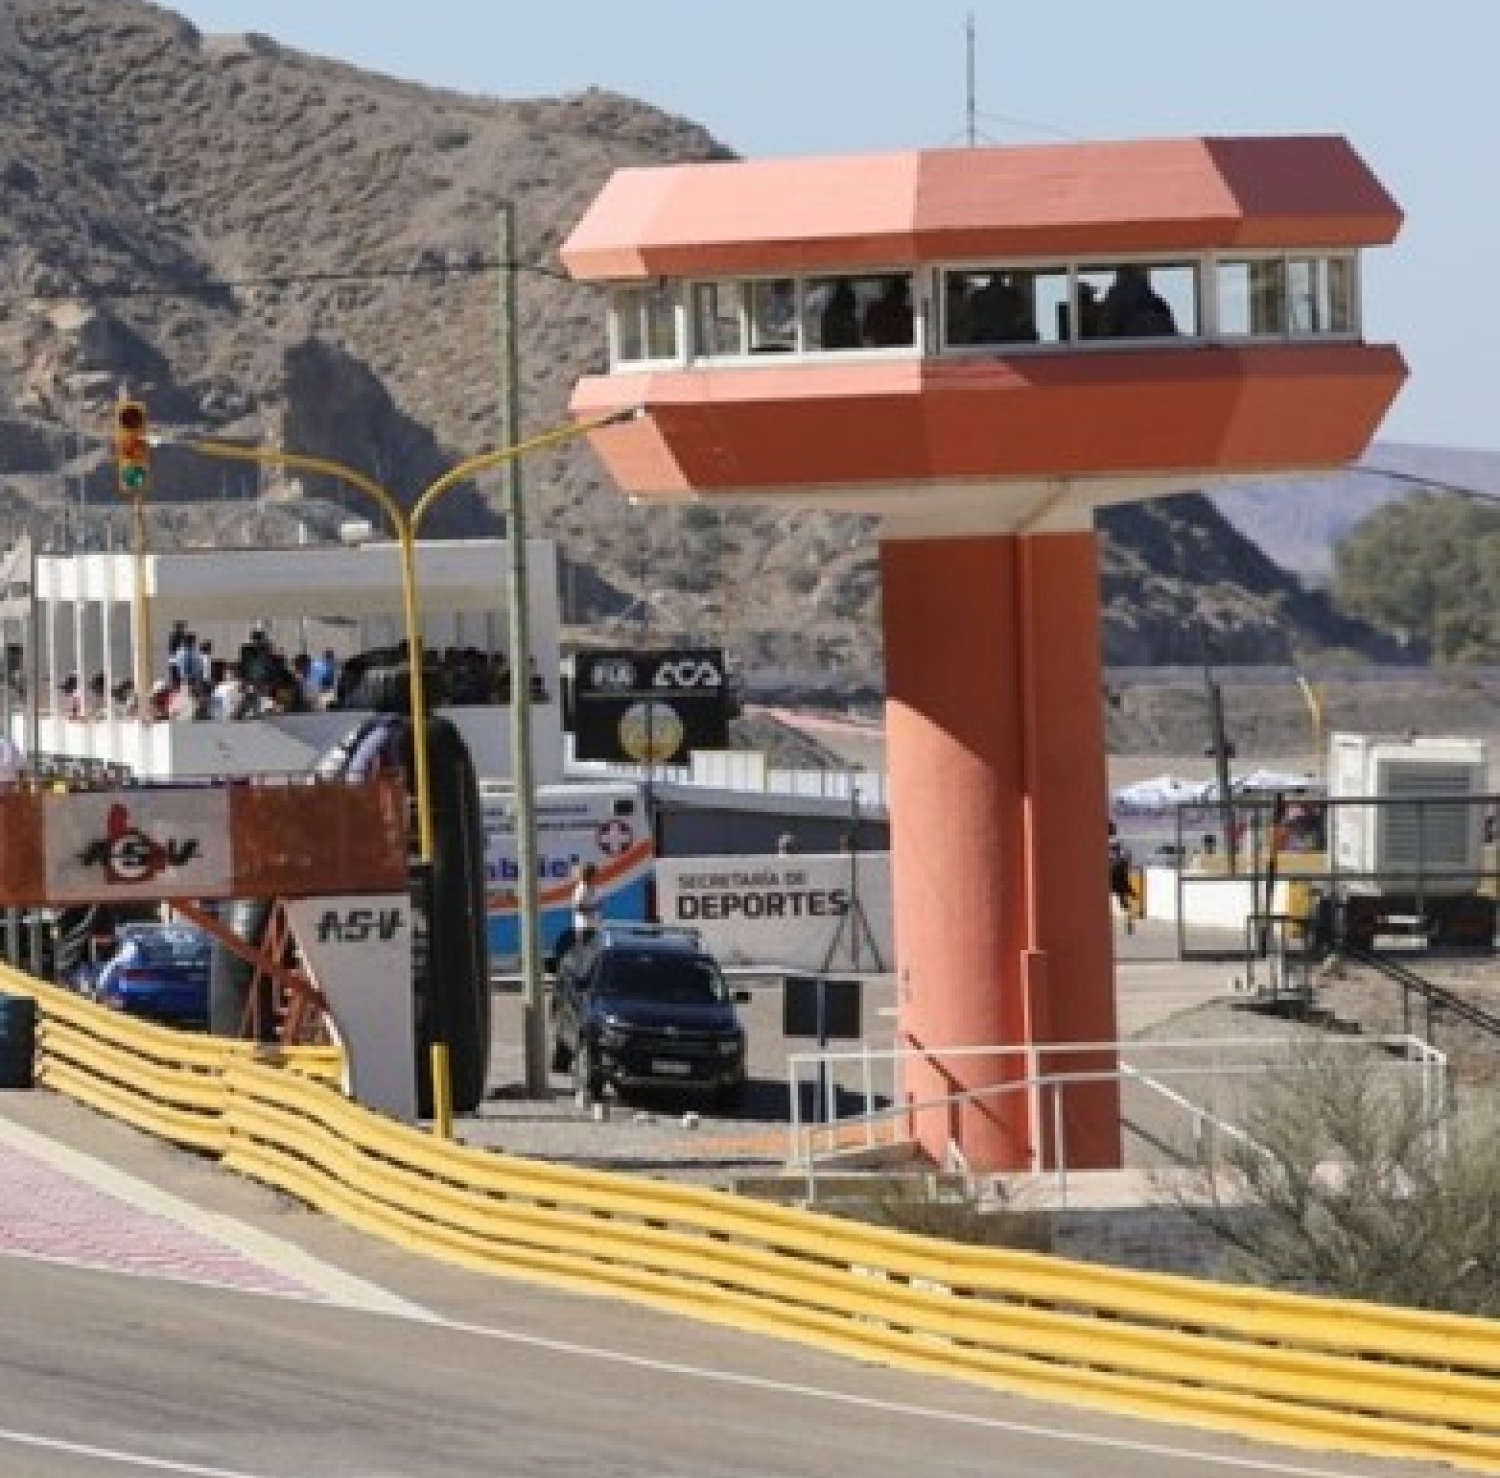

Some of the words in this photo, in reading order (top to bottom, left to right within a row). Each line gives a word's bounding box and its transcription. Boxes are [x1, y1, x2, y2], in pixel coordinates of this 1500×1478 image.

[653, 661, 722, 686] ACA
[677, 866, 779, 889] SECRETARÍA
[784, 869, 807, 886] DE
[677, 889, 850, 920] DEPORTES
[315, 907, 407, 942] ASV
